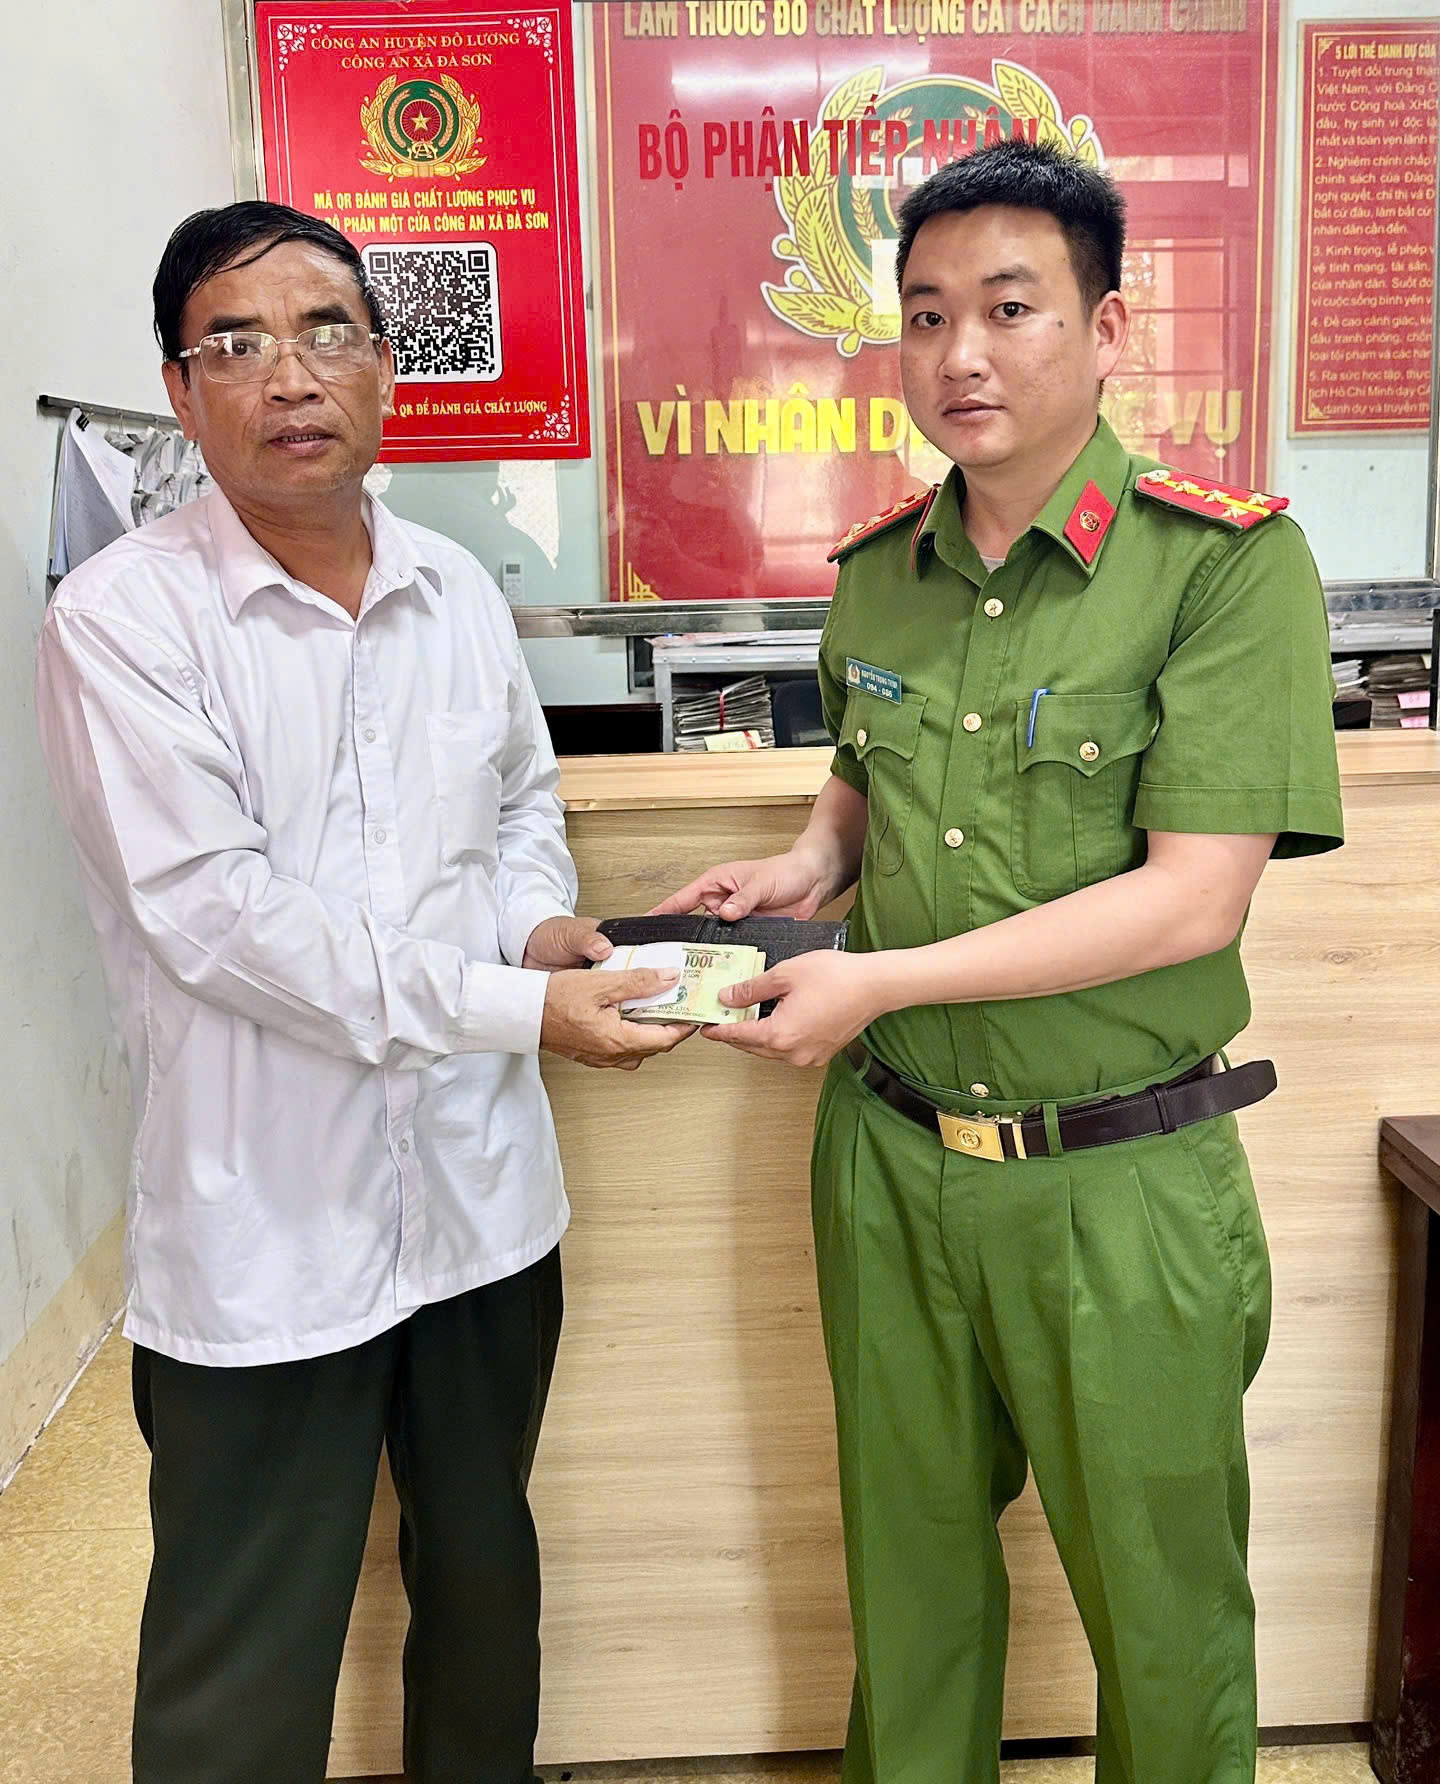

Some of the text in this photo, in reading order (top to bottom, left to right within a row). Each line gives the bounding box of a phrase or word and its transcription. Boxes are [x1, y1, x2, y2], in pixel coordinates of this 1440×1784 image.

[773, 1, 807, 36] ĐO
[311, 32, 520, 51] CÔNG AN HUYỆN ĐÔ LƯƠNG
[341, 53, 493, 69] CÔNG AN XÃ ĐÀ SƠN
[1335, 45, 1341, 60] 5
[1377, 44, 1402, 58] DANH
[1384, 66, 1413, 79] trung
[1316, 83, 1338, 96] Việt
[1344, 117, 1358, 131] hy
[1361, 117, 1385, 129] sinh
[639, 109, 689, 191] BỘ
[704, 105, 810, 192] PHẬN
[824, 94, 908, 177] TIẾP
[313, 189, 333, 209] MÃ
[336, 192, 352, 211] QR
[391, 190, 410, 209] GIÁ
[414, 185, 443, 209] CHẤT
[446, 190, 484, 210] LƯỢNG
[487, 188, 518, 211] PHỤC
[521, 188, 536, 210] VỤ
[343, 213, 376, 237] PHẬN
[379, 212, 404, 236] MỘT
[407, 210, 431, 232] CỬA
[434, 213, 465, 232] CÔNG
[469, 214, 485, 231] AN
[488, 211, 504, 231] XÃ
[525, 211, 549, 229] SƠN
[400, 403, 414, 418] QR
[432, 399, 461, 415] ĐÁNH
[464, 399, 482, 414] GIÁ
[484, 396, 511, 414] CHẤT
[513, 400, 547, 416] LƯỢNG
[637, 384, 692, 455] VÌ
[705, 382, 856, 454] NHÂN
